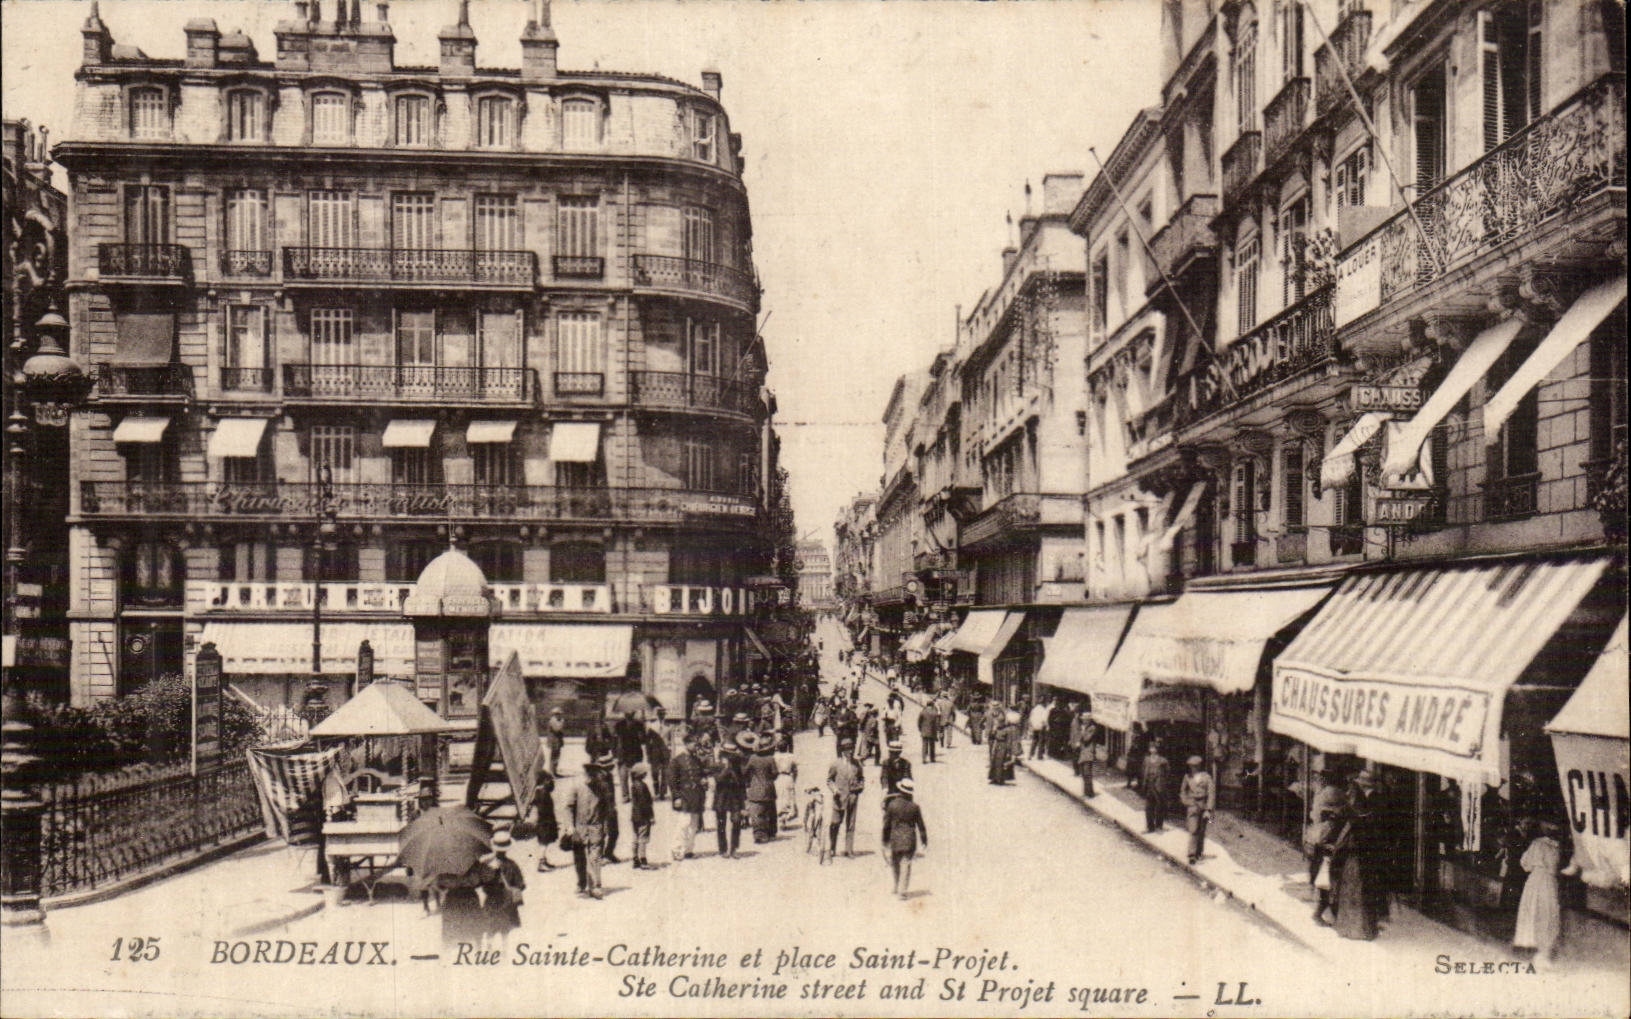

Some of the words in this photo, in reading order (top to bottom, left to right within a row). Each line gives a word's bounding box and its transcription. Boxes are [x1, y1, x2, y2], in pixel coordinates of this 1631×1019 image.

[1346, 243, 1377, 278] LOUER
[1281, 675, 1391, 729] CHAUSSURES
[1395, 693, 1472, 742] ANDRÉ
